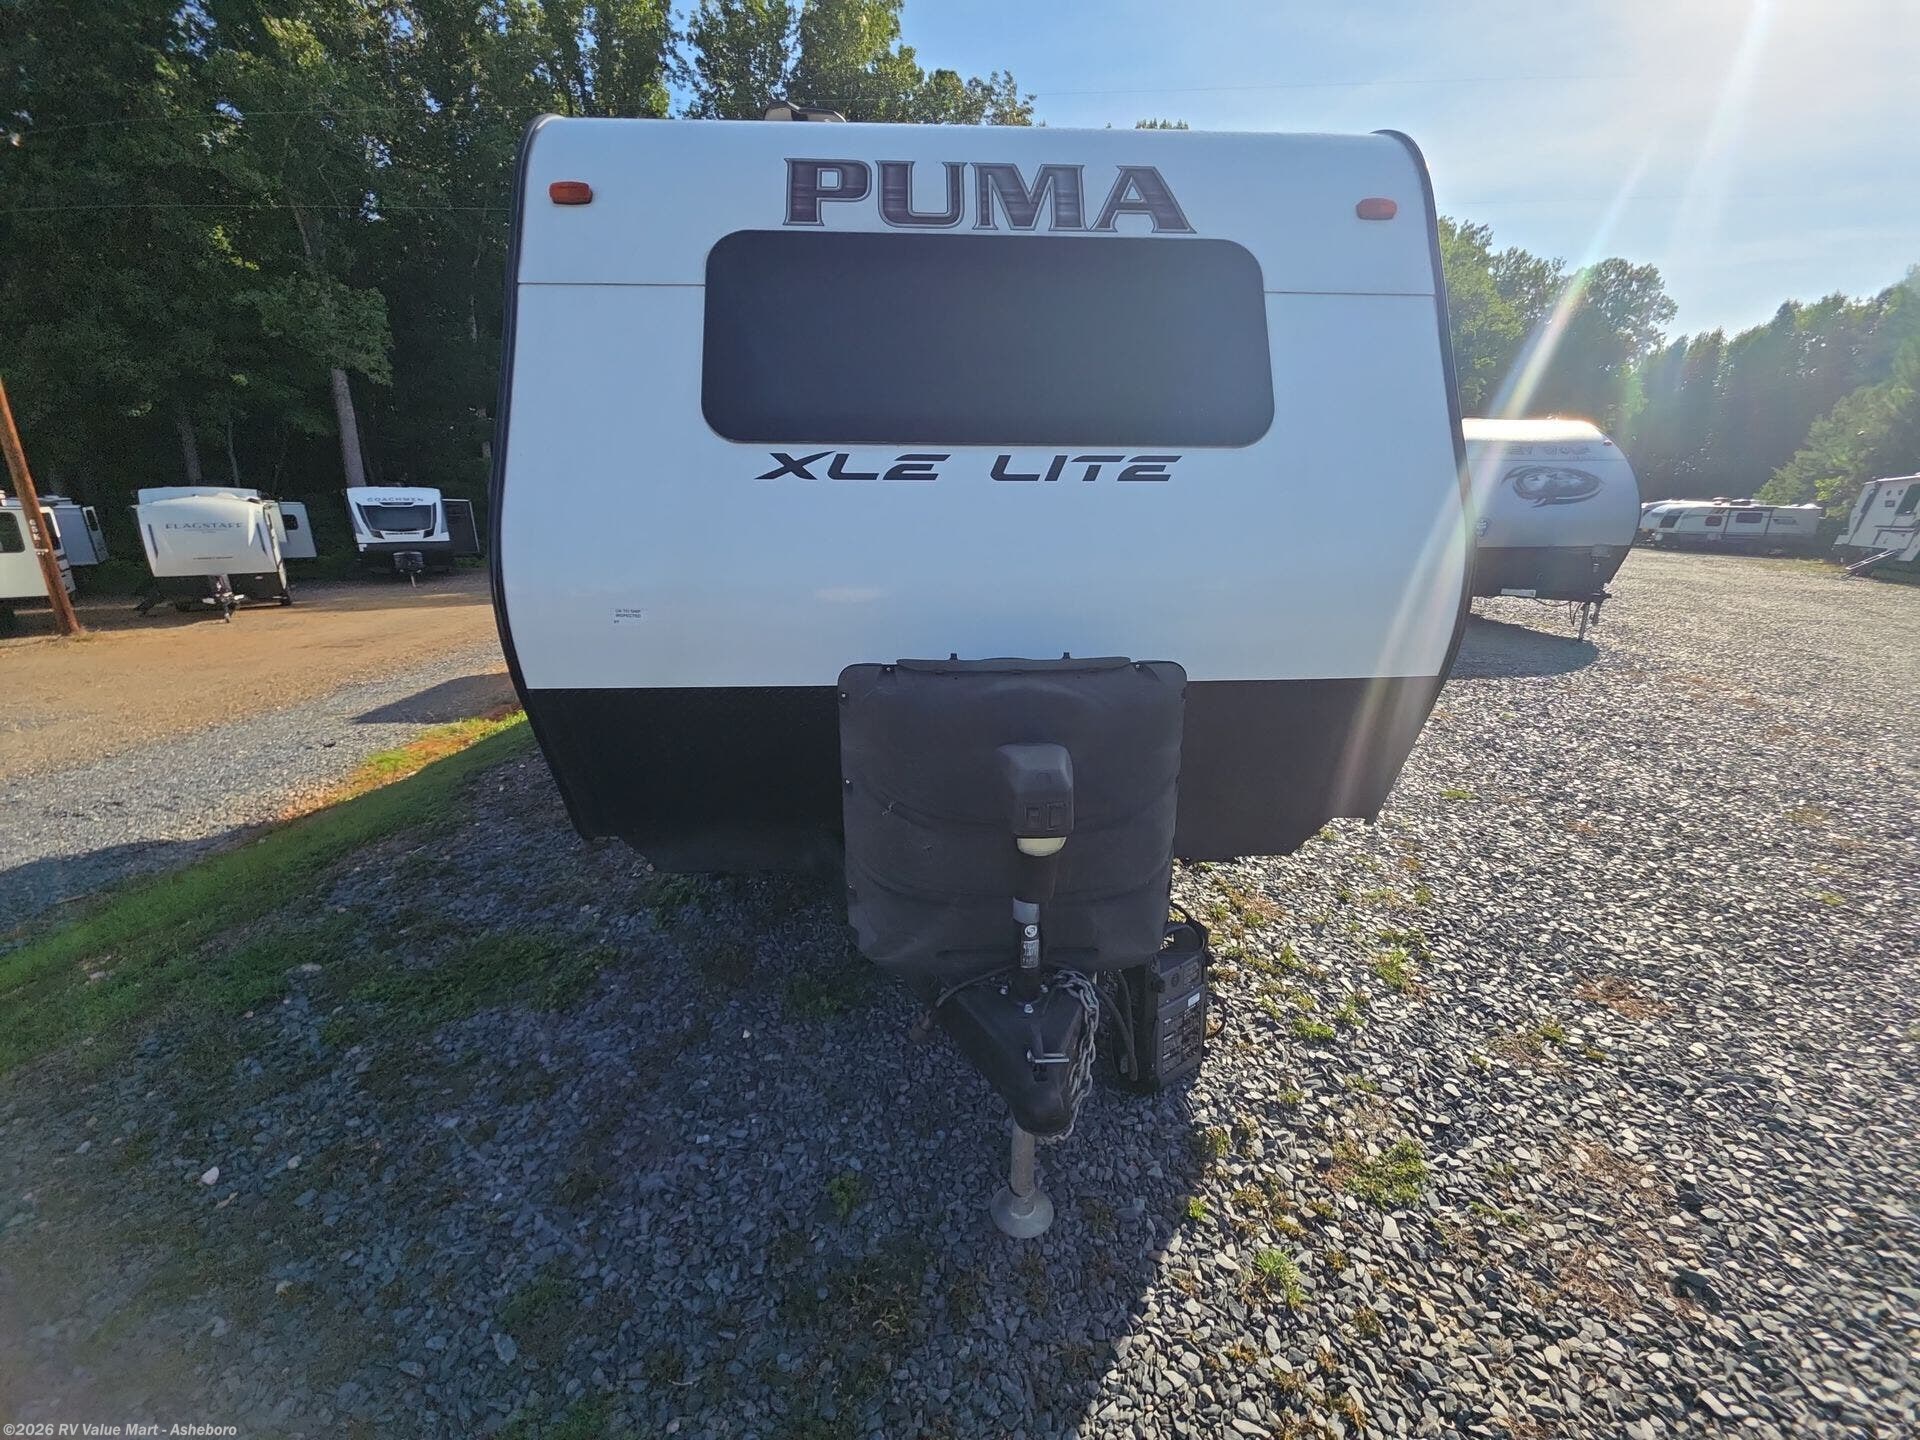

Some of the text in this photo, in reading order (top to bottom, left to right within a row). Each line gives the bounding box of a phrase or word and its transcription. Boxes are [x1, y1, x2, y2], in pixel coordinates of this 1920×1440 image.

[783, 157, 1197, 234] PUMA
[754, 450, 1182, 482] XLE LITE
[165, 521, 244, 530] FLAGSTAFF
